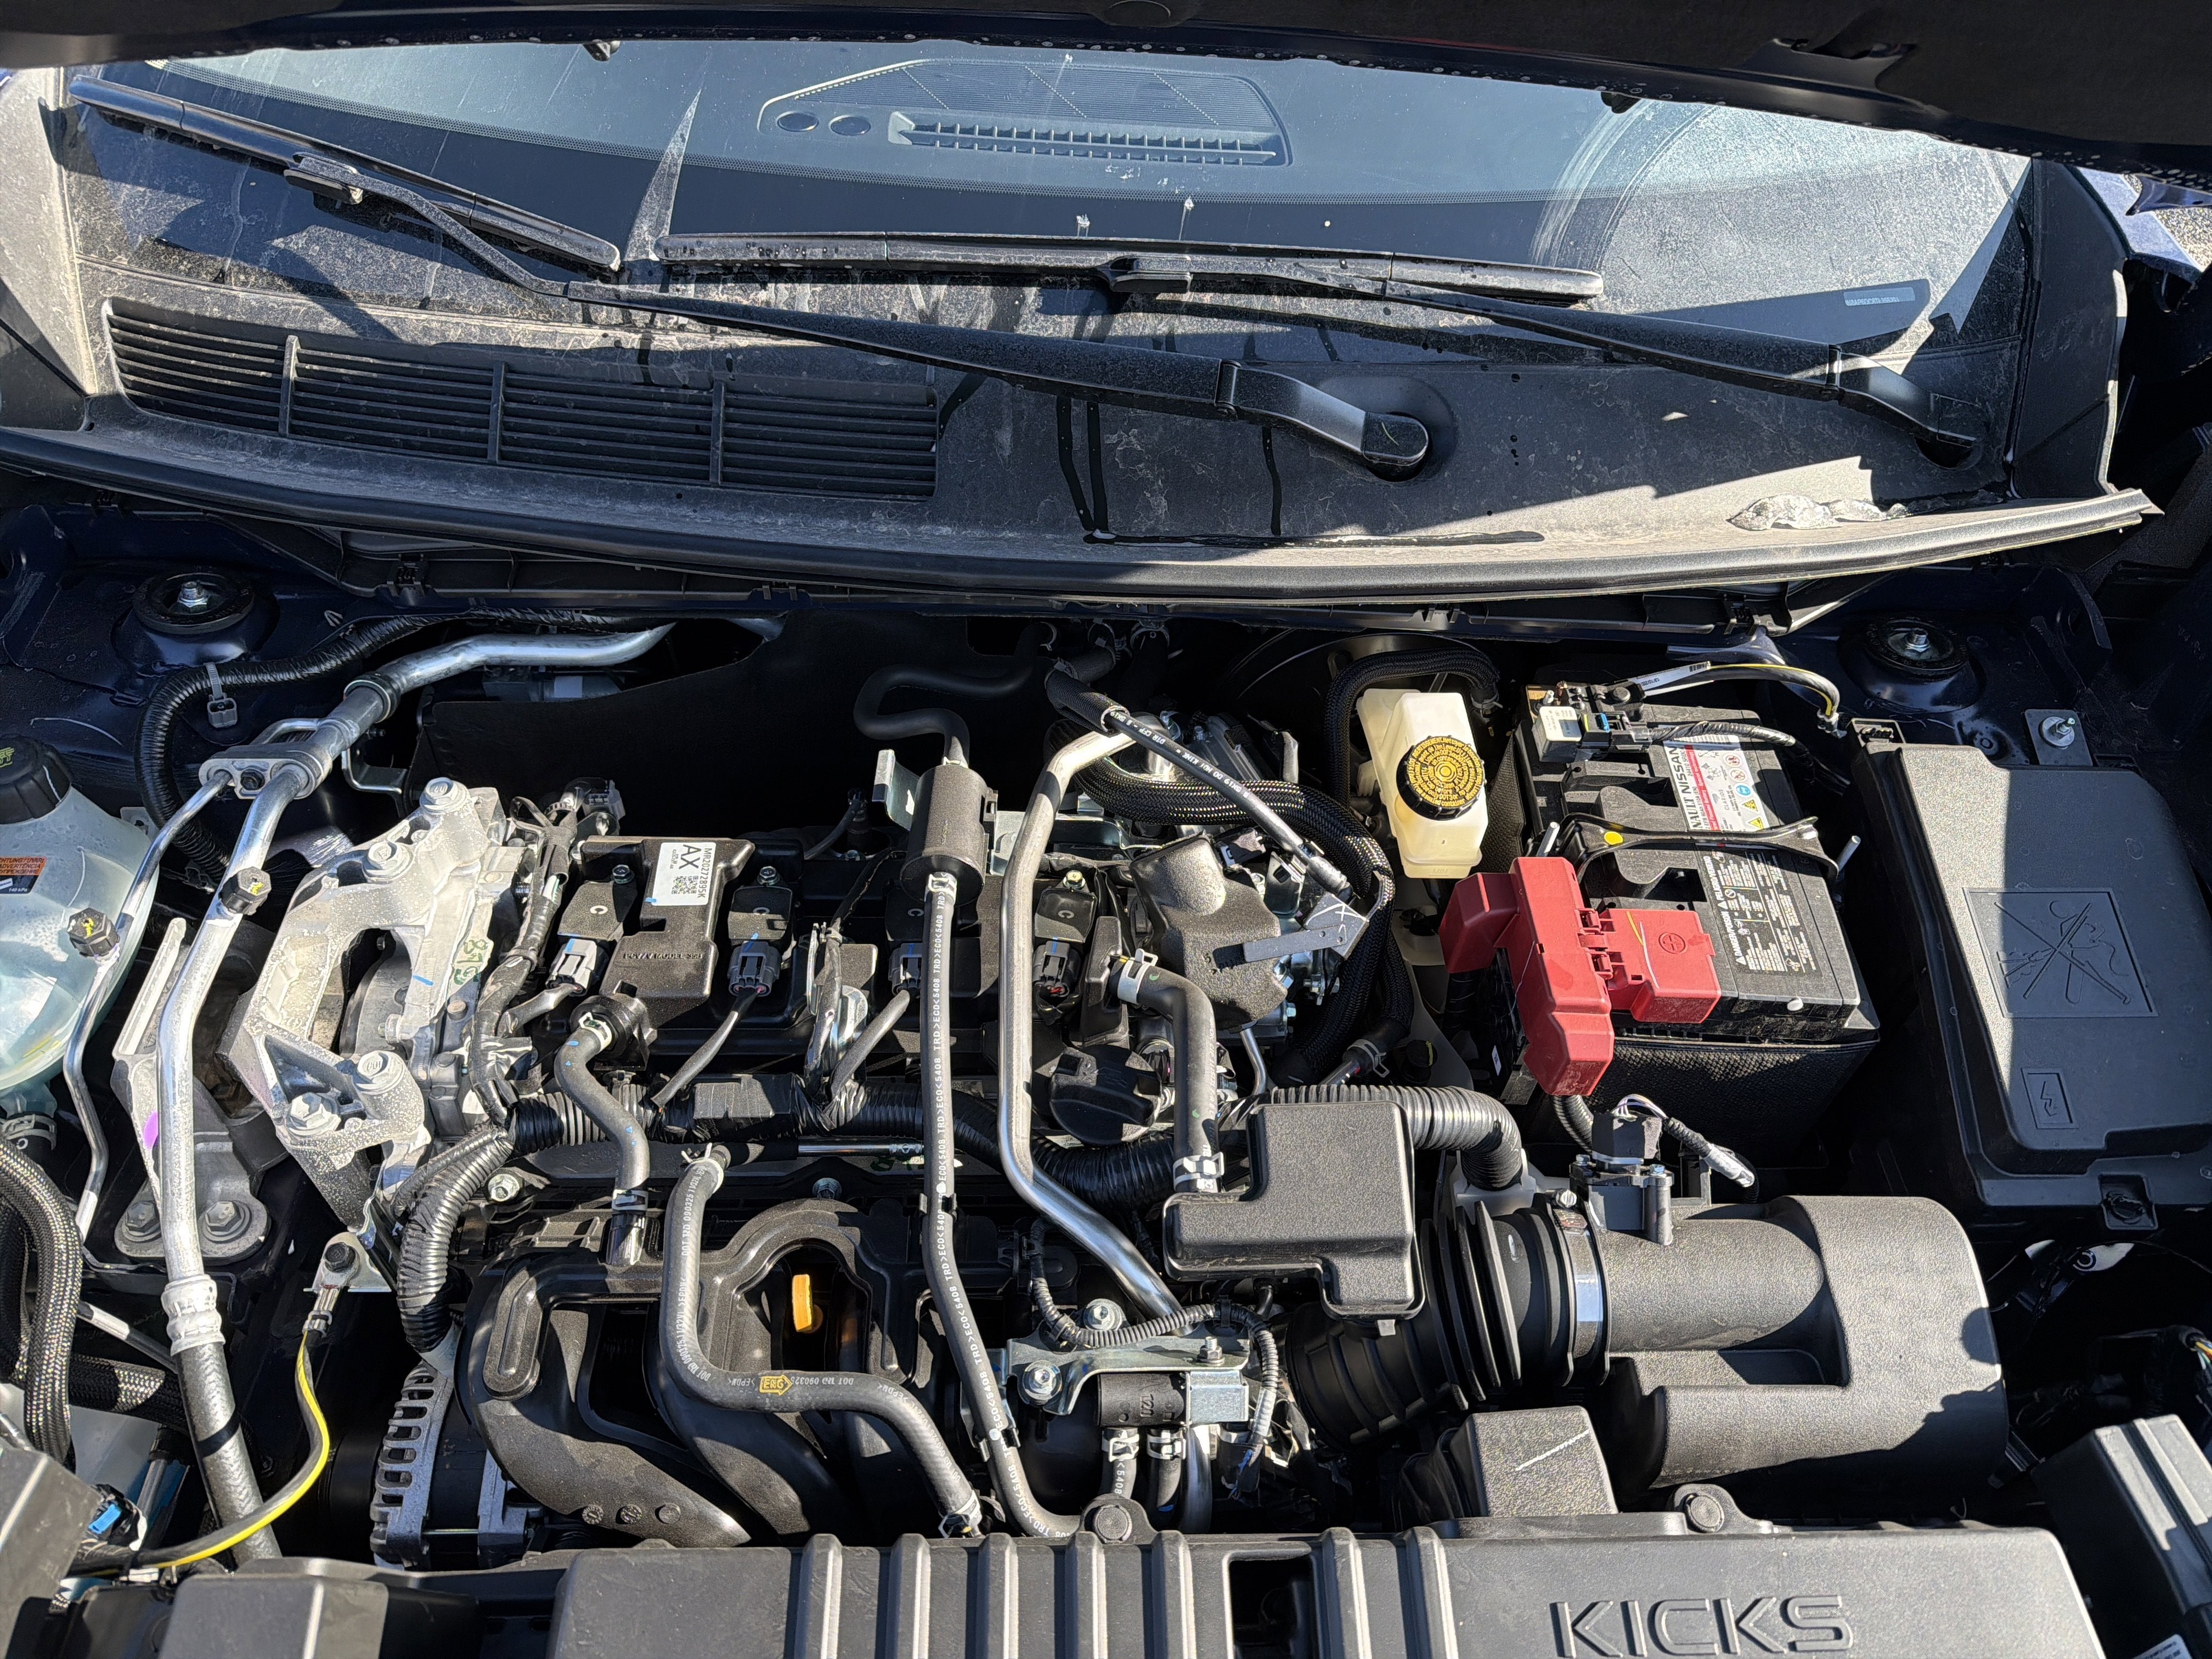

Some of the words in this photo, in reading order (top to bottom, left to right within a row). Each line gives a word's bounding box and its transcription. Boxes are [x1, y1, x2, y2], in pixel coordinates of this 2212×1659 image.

[1669, 746, 1691, 794] NISSAN
[679, 844, 702, 870] AX
[697, 848, 712, 898] MR20272895K
[933, 915, 943, 973] TRD>ECO<5408
[763, 1379, 784, 1389] ENG
[1550, 1595, 1854, 1658] KICKS
